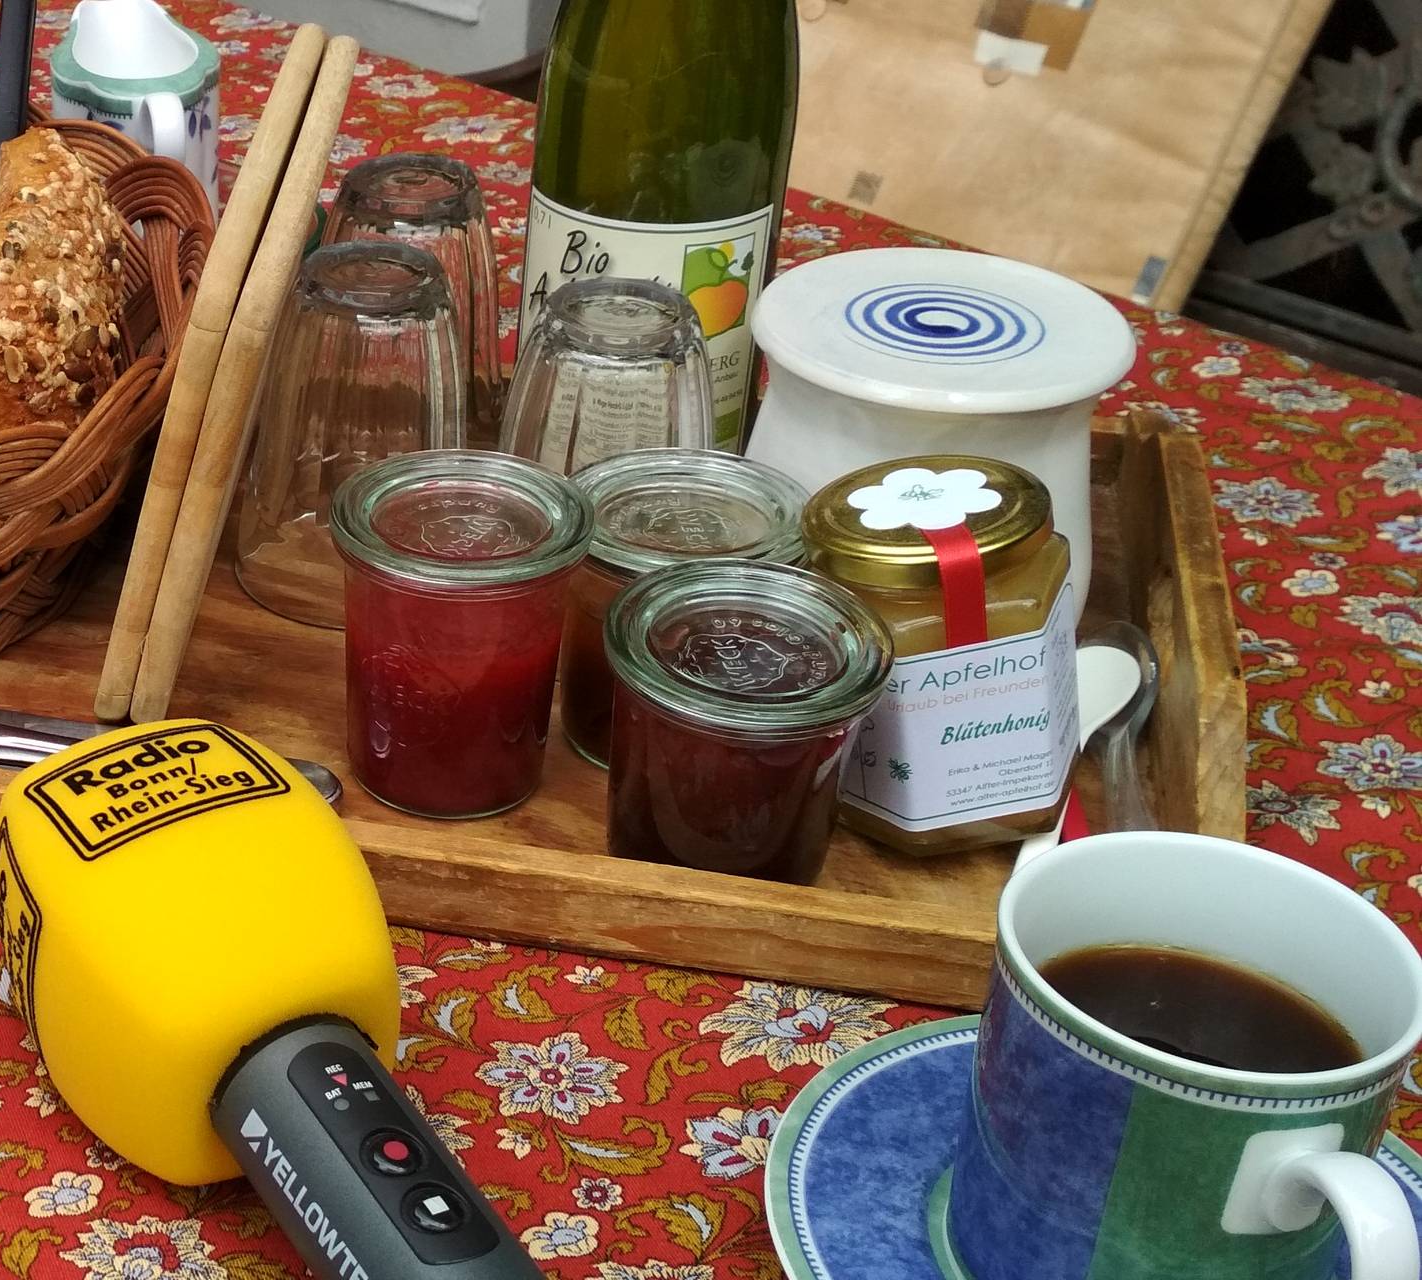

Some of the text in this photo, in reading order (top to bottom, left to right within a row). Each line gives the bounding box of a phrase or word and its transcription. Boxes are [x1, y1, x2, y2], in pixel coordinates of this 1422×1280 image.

[560, 229, 611, 275] Bio
[709, 350, 743, 373] ERG
[711, 638, 756, 688] WECK
[885, 645, 1047, 695] er Apfelhof
[942, 692, 970, 706] bei
[940, 707, 1051, 746] Blütenhonig
[61, 738, 211, 796] Radio
[972, 763, 980, 772] &
[982, 755, 1021, 769] Michael
[998, 762, 1042, 777] Oberdorf
[108, 758, 198, 799] Bonn/
[90, 769, 255, 832] Rhein-Sieg
[946, 785, 973, 798] 53347
[324, 1063, 344, 1075] REC
[324, 1087, 343, 1101] BAT
[352, 1080, 374, 1091] MEM
